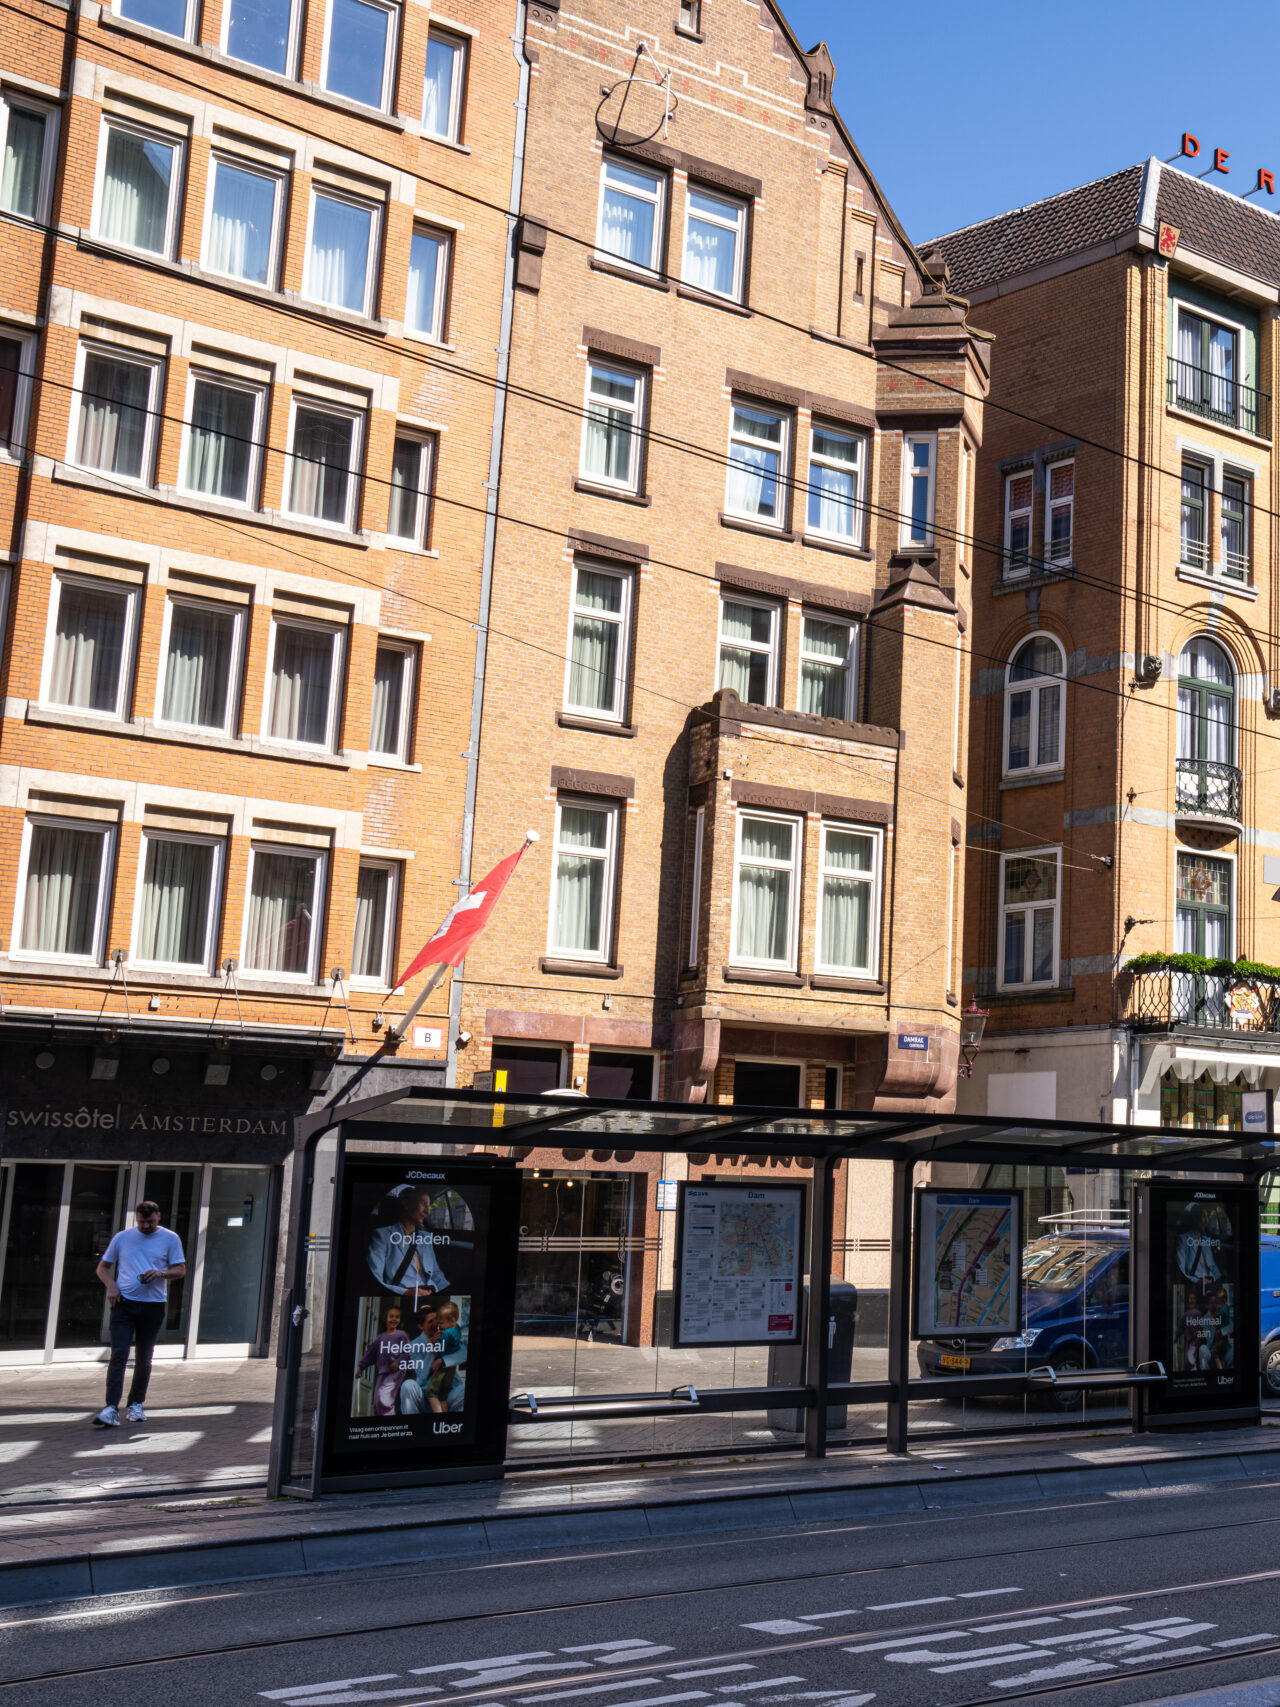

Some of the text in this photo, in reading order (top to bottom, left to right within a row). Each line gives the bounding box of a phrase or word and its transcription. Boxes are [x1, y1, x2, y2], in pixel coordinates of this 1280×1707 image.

[1182, 132, 1230, 174] DE
[904, 1036, 924, 1044] DAMRAK
[7, 1103, 287, 1135] swissôtel AMSTERDAM
[406, 1170, 446, 1180] JCDecaux
[390, 1232, 450, 1248] Opladen
[1186, 1236, 1220, 1248] Opladen
[1186, 1316, 1222, 1326] Helemaal
[1197, 1330, 1211, 1338] aan
[380, 1340, 446, 1354] Helemaal
[398, 1360, 424, 1370] aan
[1217, 1376, 1234, 1385] Uber
[432, 1422, 463, 1434] Uber
